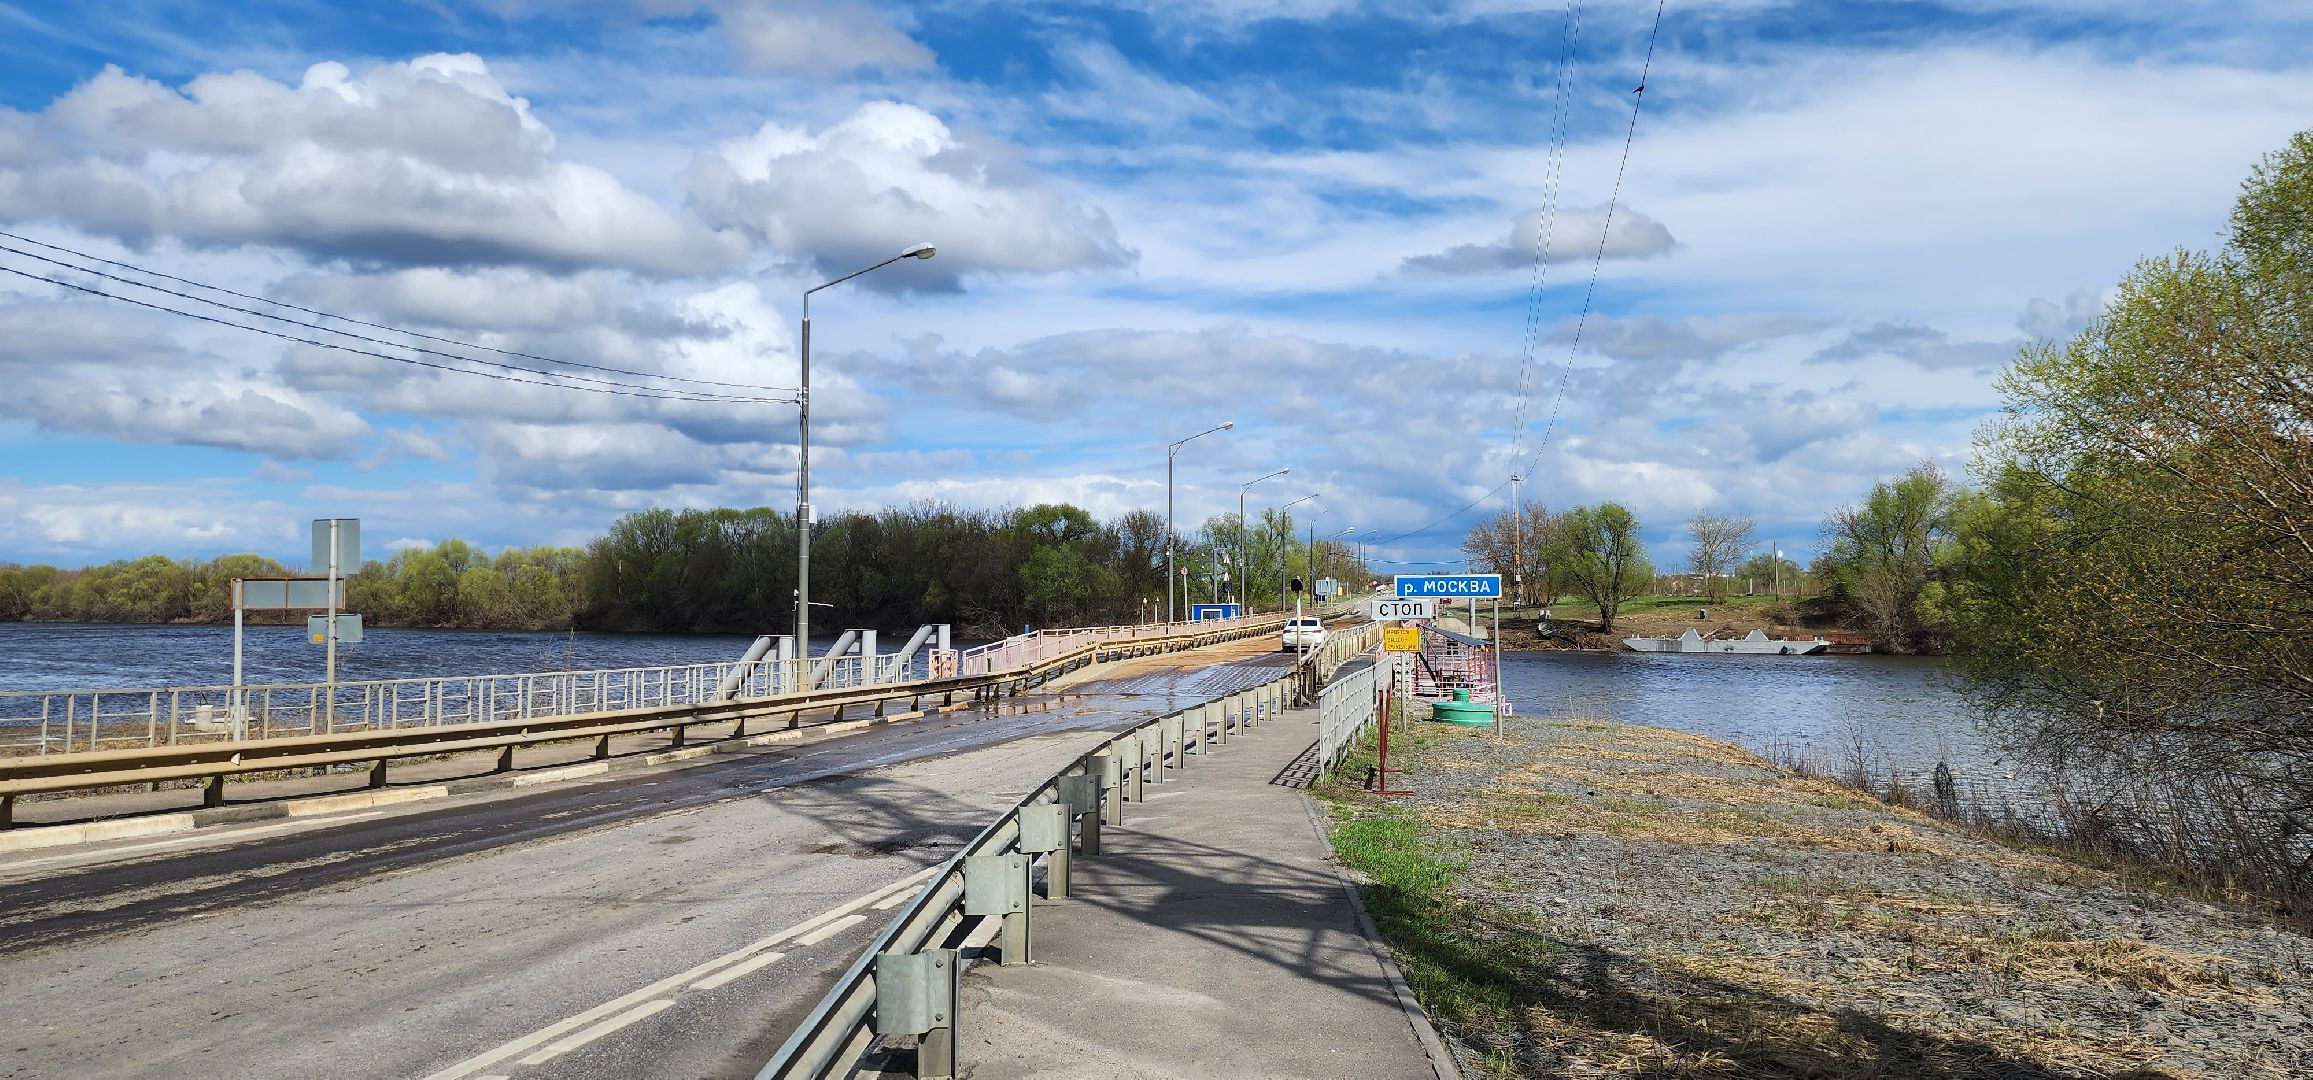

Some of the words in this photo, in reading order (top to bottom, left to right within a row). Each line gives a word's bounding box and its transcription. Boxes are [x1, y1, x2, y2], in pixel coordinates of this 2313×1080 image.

[1404, 583, 1417, 596] р.
[1423, 580, 1491, 593] МОСКВА
[1379, 603, 1423, 616] СТОП
